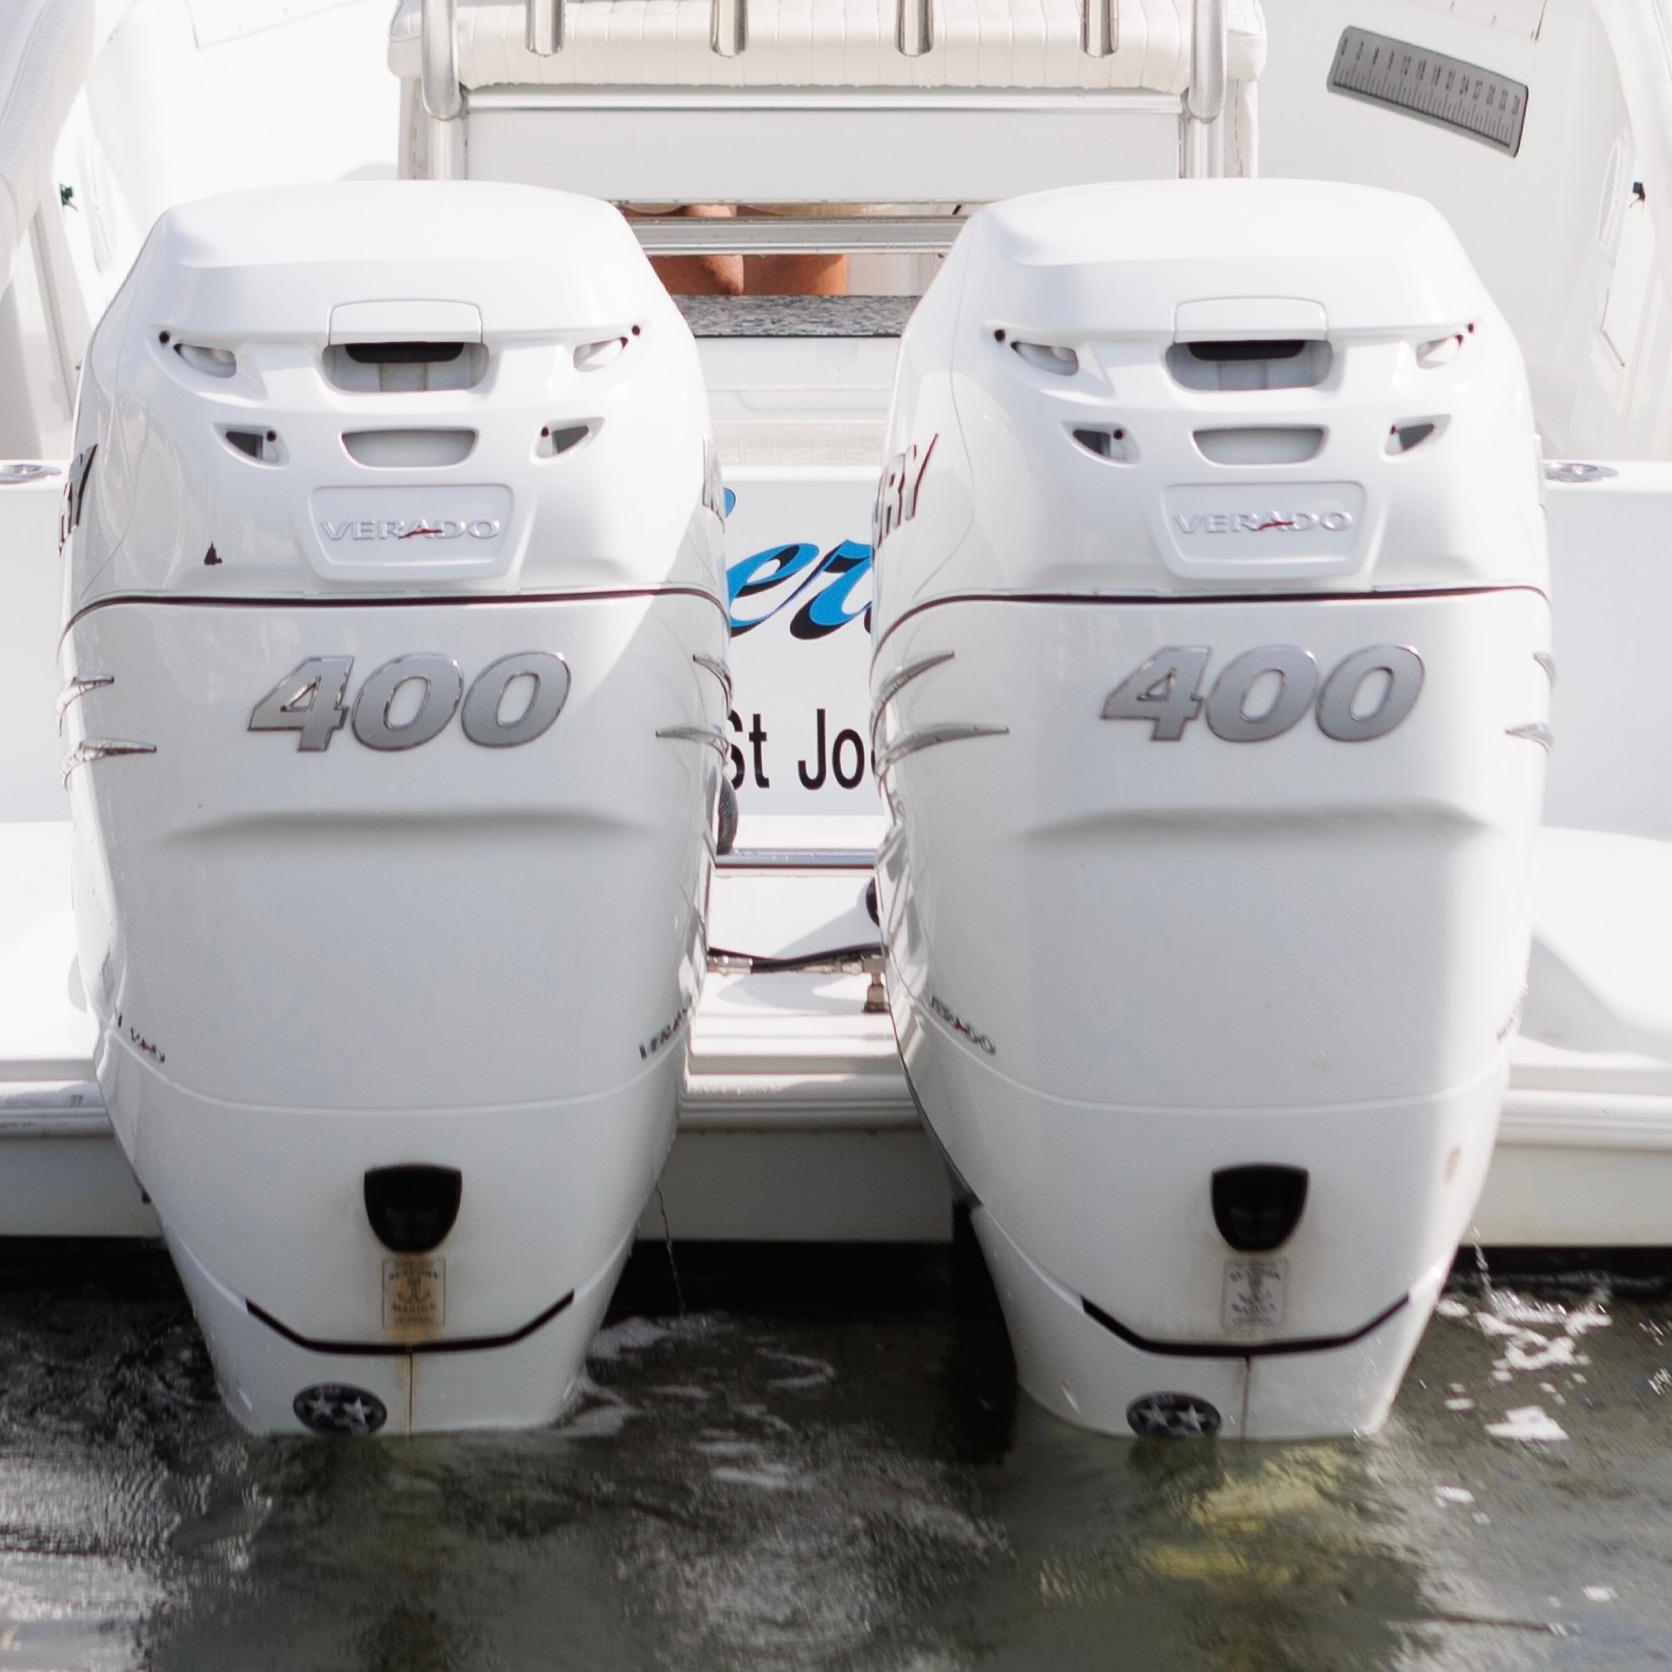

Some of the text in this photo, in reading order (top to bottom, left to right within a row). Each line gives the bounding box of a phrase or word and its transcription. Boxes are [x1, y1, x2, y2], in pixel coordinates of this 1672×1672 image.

[320, 518, 501, 541] VERADO
[1172, 510, 1353, 535] VERADO
[246, 649, 572, 753] 400
[1099, 642, 1426, 744] 400
[797, 707, 875, 791] Jo
